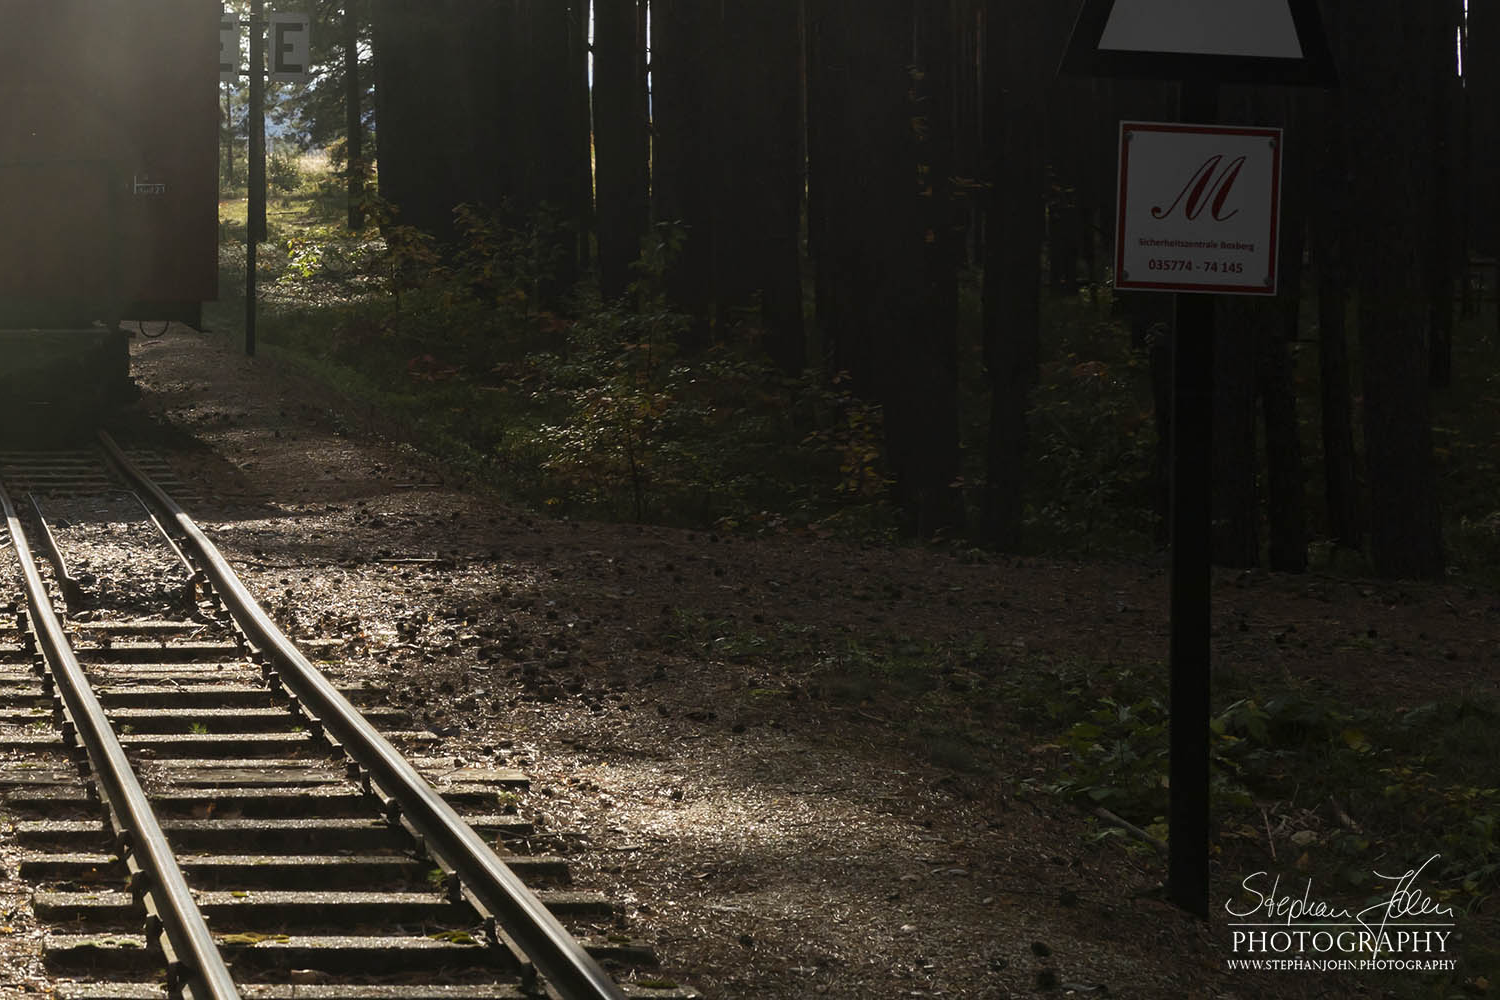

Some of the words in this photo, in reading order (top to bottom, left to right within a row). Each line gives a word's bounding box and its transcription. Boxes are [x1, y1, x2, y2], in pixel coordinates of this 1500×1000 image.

[275, 22, 303, 73] E
[1151, 154, 1247, 222] M
[1148, 258, 1192, 272] 035774
[1204, 261, 1218, 273] 74
[1222, 262, 1243, 273] 145
